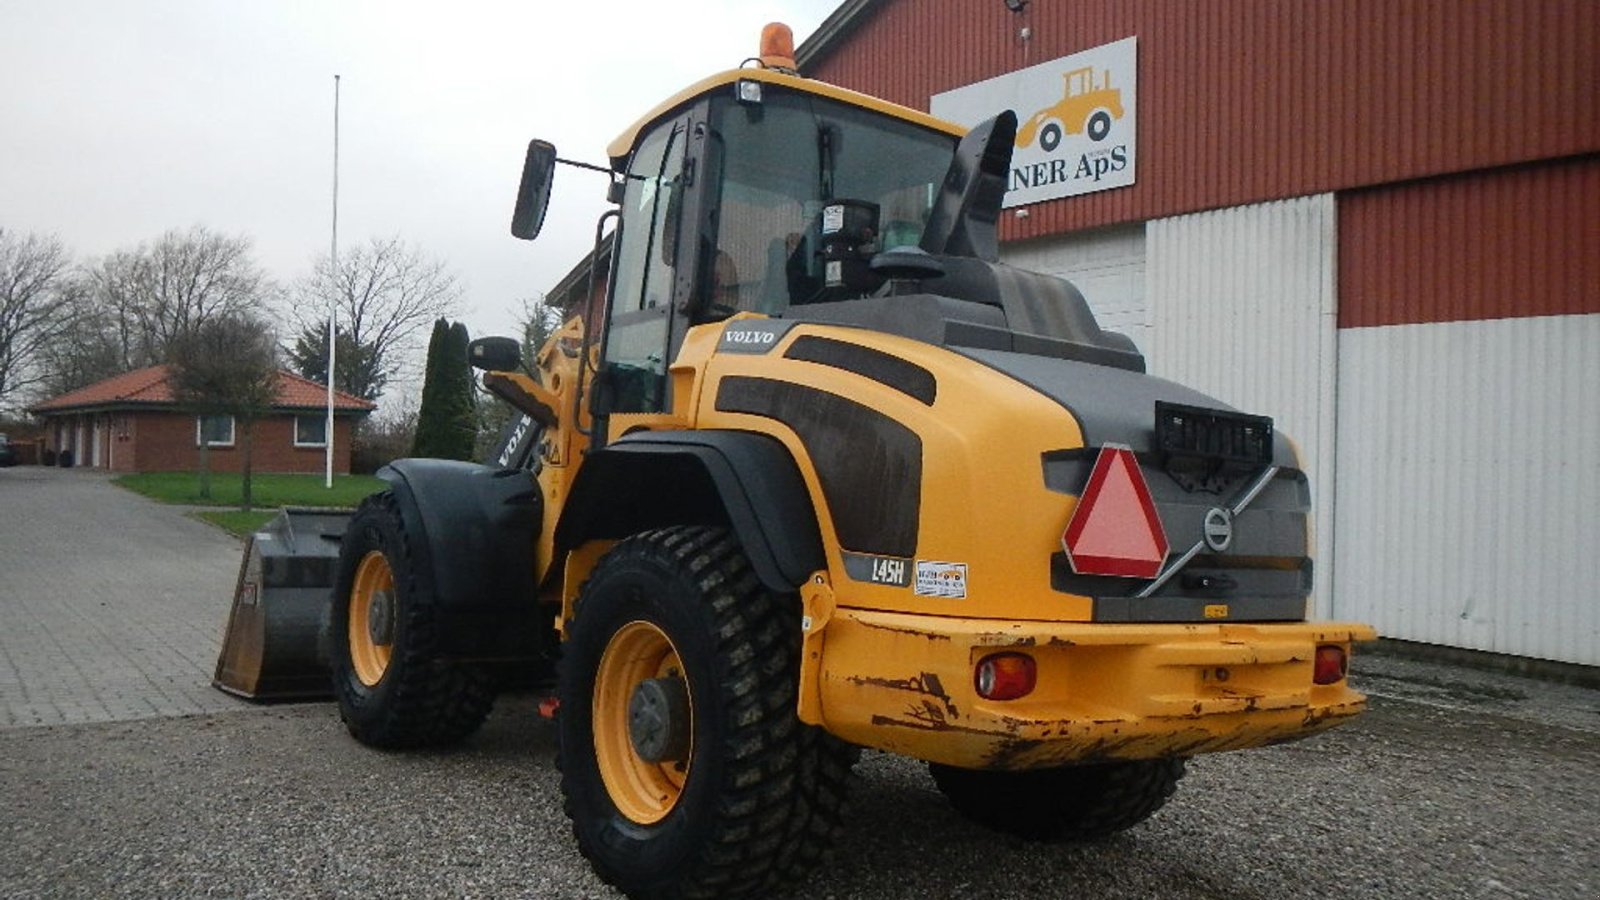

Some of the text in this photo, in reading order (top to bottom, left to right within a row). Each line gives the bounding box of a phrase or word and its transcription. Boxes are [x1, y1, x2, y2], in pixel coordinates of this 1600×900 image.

[1007, 145, 1127, 192] NER ApS
[725, 331, 775, 344] VOLVO
[498, 414, 532, 467] VOLV
[871, 558, 905, 583] L45H
